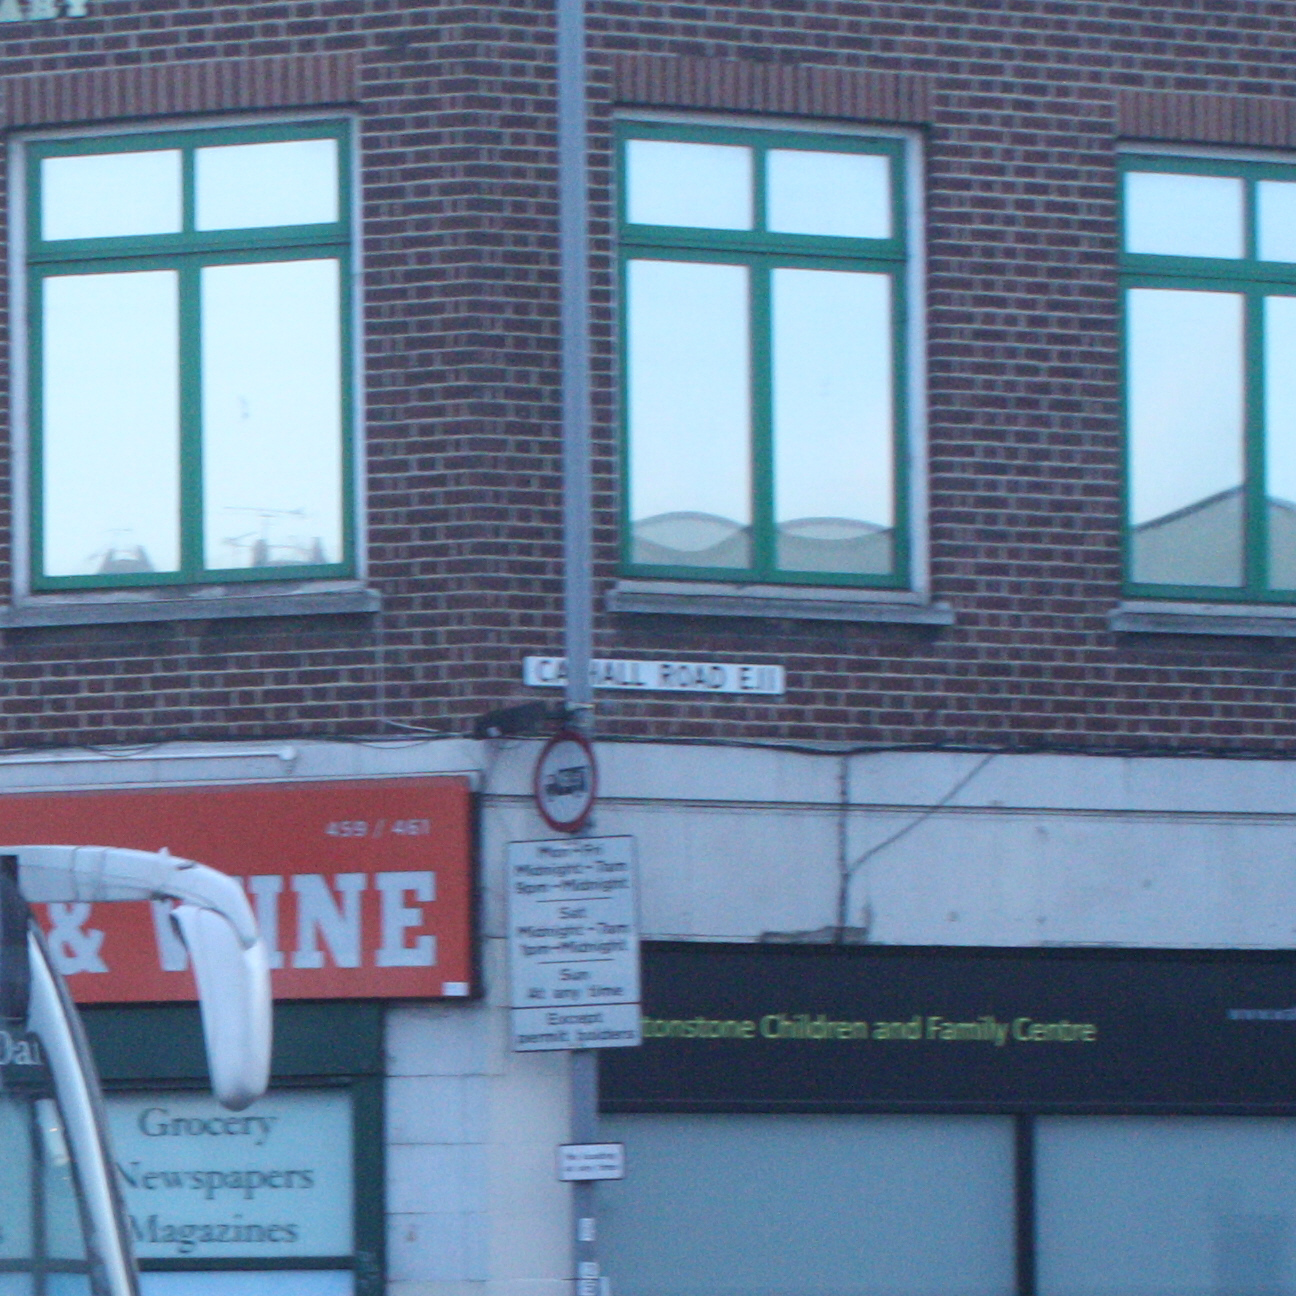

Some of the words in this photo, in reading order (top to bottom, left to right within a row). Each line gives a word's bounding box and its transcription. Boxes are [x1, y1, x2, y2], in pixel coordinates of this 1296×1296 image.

[534, 659, 647, 686] CAHALL
[660, 663, 726, 690] ROAD
[760, 1013, 868, 1039] Children
[873, 1015, 922, 1040] and
[926, 1015, 1008, 1046] Family
[1012, 1016, 1097, 1042] Centre
[136, 1107, 277, 1146] Grocery
[115, 1161, 315, 1200] Newspapers
[127, 1213, 299, 1254] Magazines
